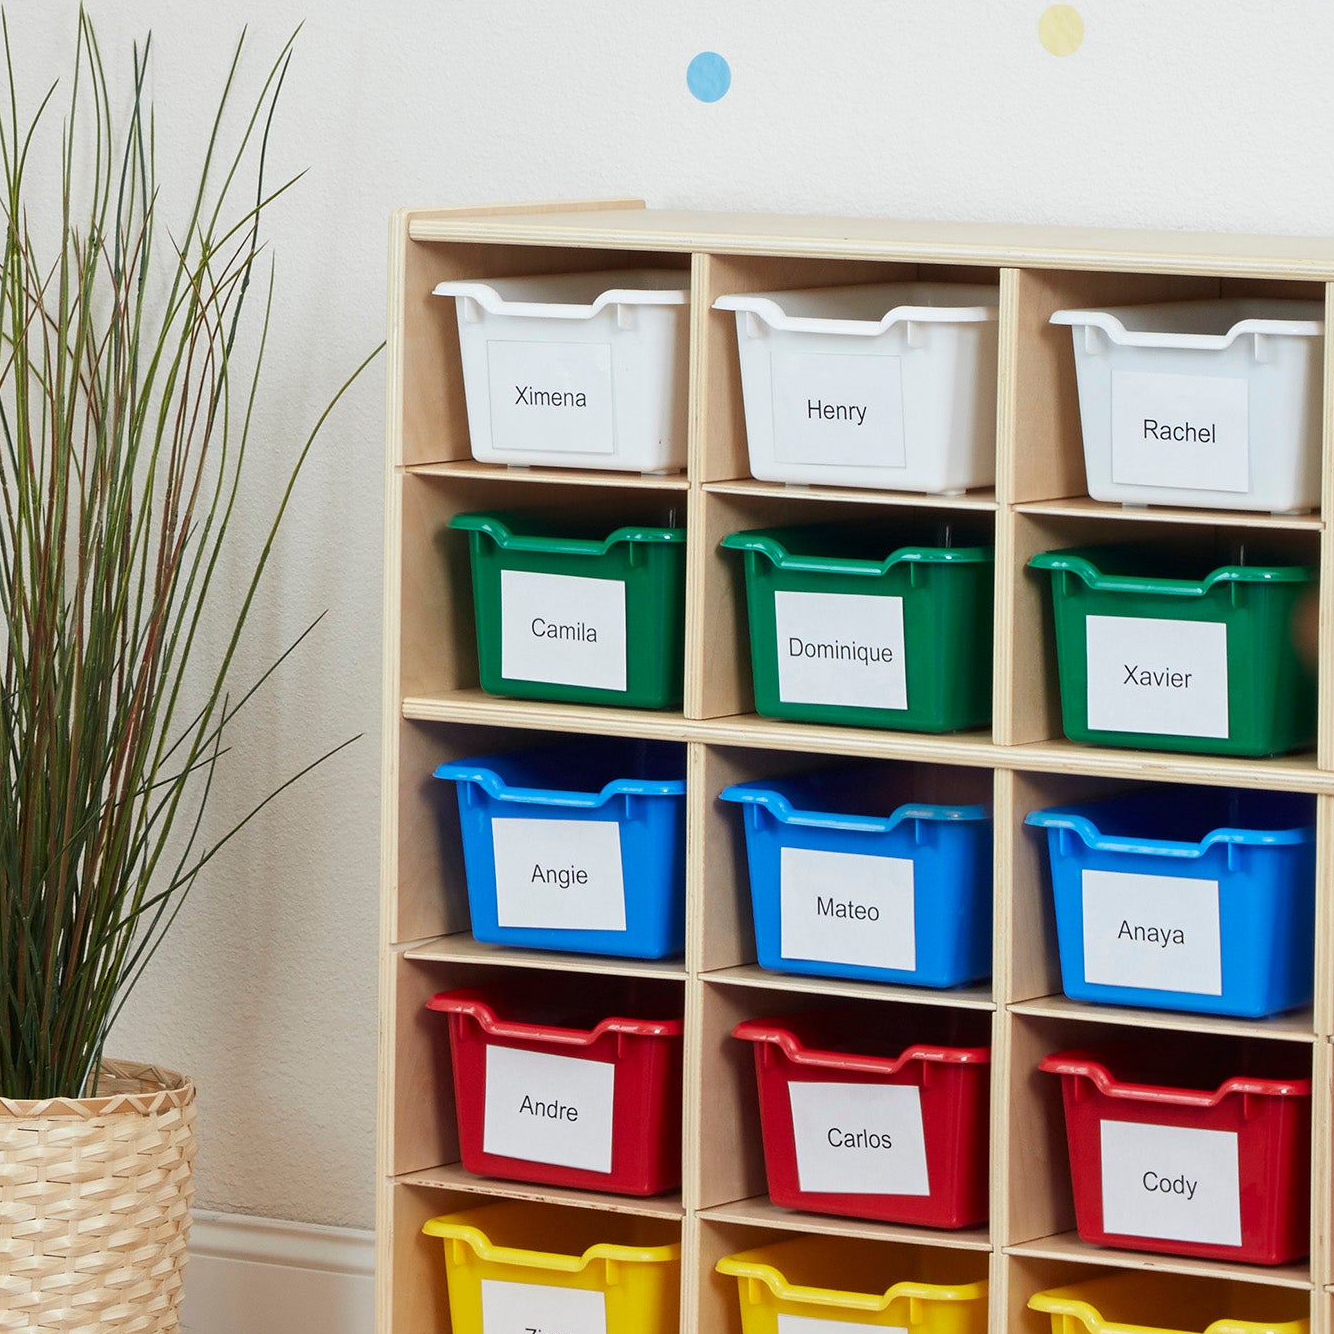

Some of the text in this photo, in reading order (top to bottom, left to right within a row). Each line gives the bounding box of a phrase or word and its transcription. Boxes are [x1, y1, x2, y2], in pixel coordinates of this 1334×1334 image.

[514, 385, 587, 408] Ximena
[807, 399, 867, 426] Henry
[1143, 418, 1216, 444] Rachel
[531, 617, 598, 643] Camila
[789, 637, 893, 667] Dominique
[1123, 664, 1193, 689] Xavier
[531, 863, 588, 890] Angie
[817, 896, 880, 922] Mateo
[1117, 919, 1185, 949] Anaya
[518, 1094, 579, 1122] Andre
[827, 1127, 893, 1150] Carlos
[1142, 1170, 1198, 1201] Cody
